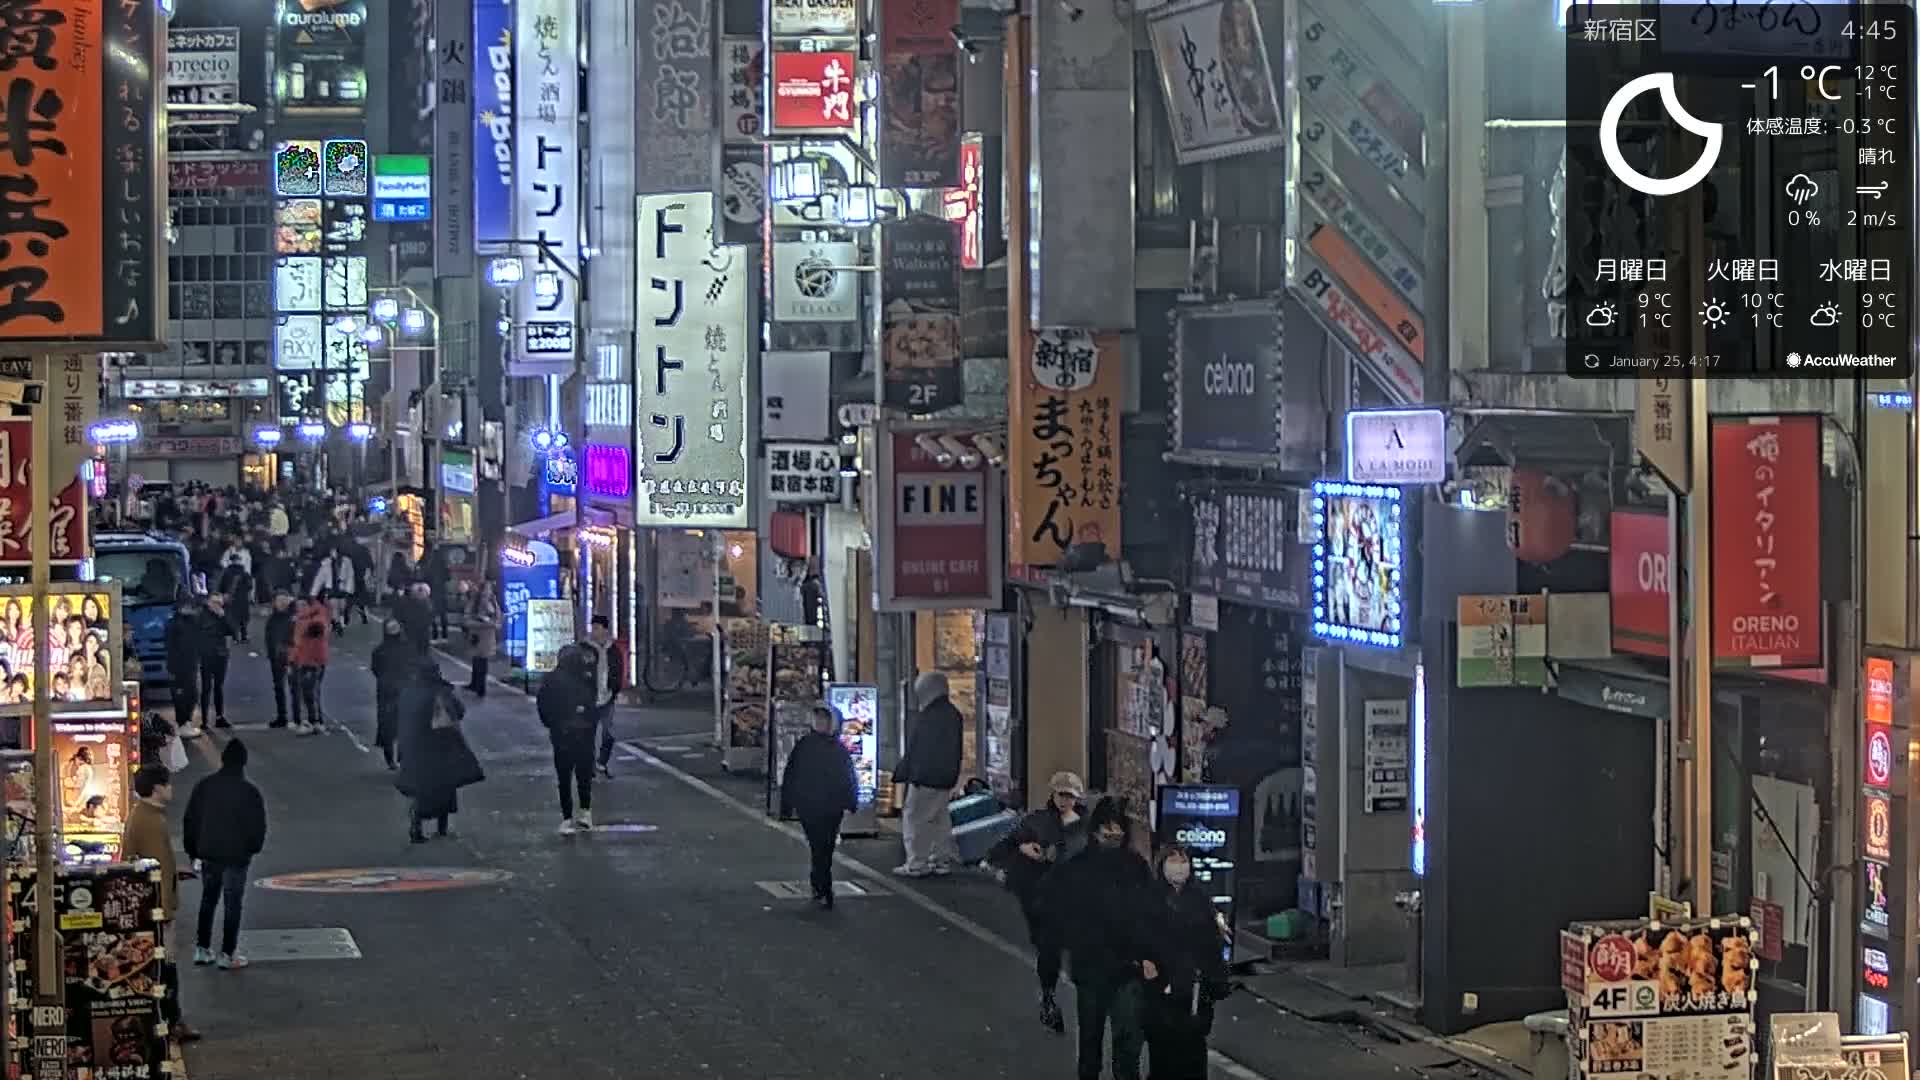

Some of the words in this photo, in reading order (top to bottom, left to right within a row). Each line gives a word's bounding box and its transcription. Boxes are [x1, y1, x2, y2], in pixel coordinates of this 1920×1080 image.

[1305, 22, 1325, 41] 5
[821, 59, 850, 120] 牛門
[1305, 74, 1324, 92] 4
[1307, 121, 1325, 142] 3
[1304, 171, 1325, 193] 2
[1303, 267, 1332, 298] B1
[649, 208, 685, 463] トントン
[1204, 352, 1255, 395] celona
[64, 354, 83, 444] 通り一番街
[909, 384, 938, 404] 2F
[771, 450, 834, 472] 酒場心
[770, 475, 835, 493] 新宿本店
[1032, 396, 1077, 550] まっちゃん
[903, 484, 977, 513] FINE
[1747, 430, 1781, 604] 俺のイタリアン
[1732, 615, 1800, 633] ORENO
[1731, 634, 1801, 651] ITALIAN
[1592, 987, 1627, 1010] 4F
[33, 1007, 64, 1026] NERO
[36, 1037, 65, 1057] NERO
